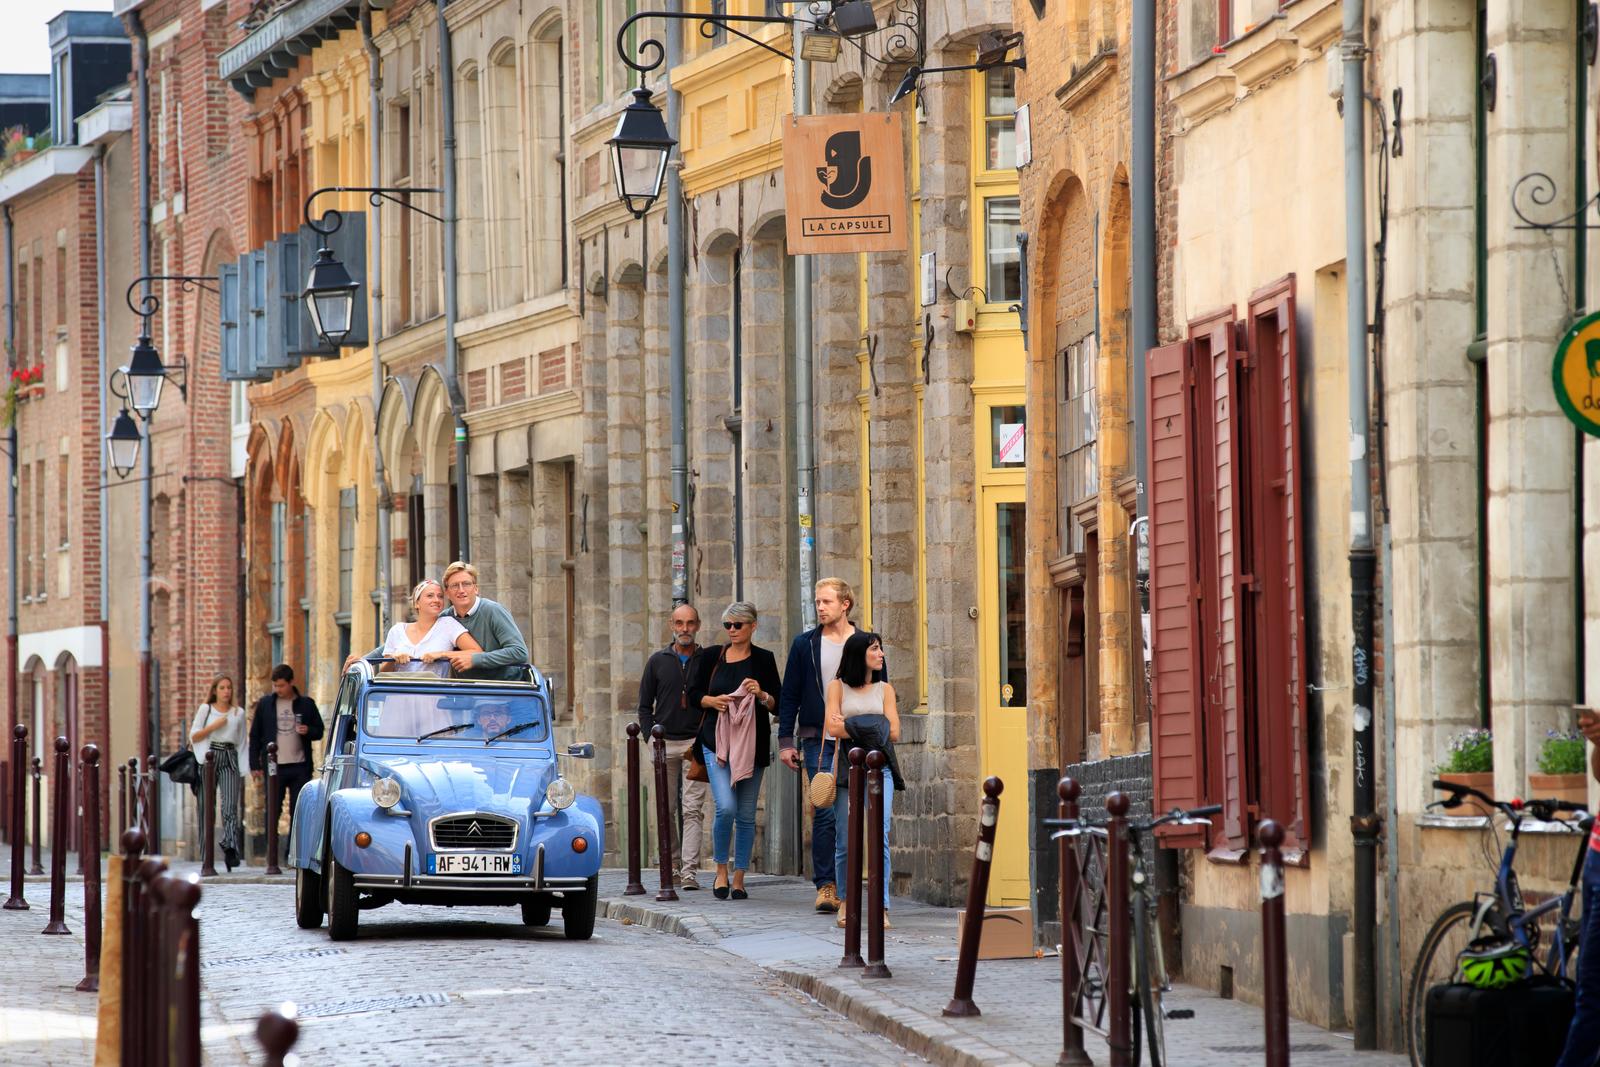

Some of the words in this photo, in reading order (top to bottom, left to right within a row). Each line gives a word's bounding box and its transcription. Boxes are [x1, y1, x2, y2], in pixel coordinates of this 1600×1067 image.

[810, 223, 824, 231] LA
[831, 220, 883, 230] CAPSULE
[513, 864, 521, 872] 59
